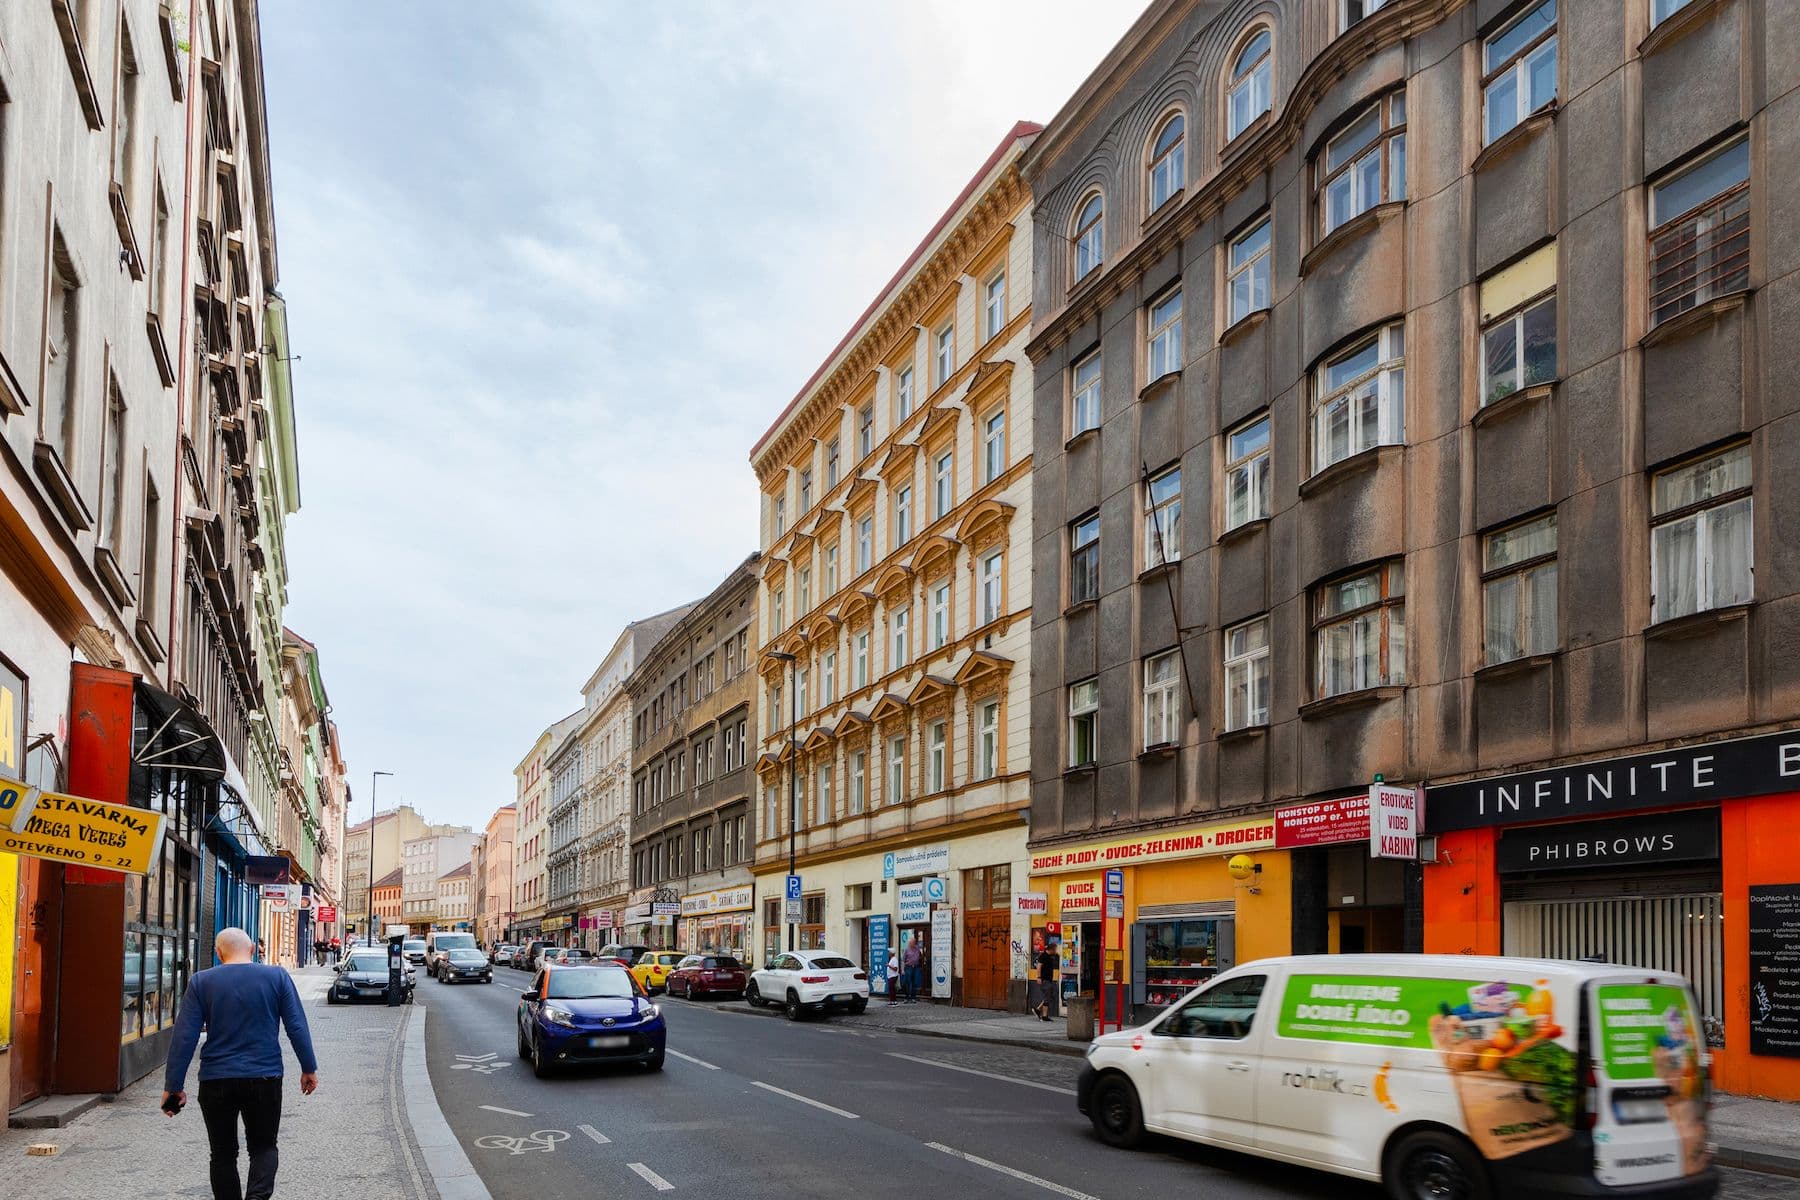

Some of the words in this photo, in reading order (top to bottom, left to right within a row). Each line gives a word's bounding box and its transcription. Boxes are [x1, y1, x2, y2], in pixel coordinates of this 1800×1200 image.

[1479, 755, 1715, 815] INFINITE
[1380, 792, 1414, 810] EROTICKÉ
[1277, 805, 1320, 819] NONSTOP
[1283, 814, 1327, 828] NONSTOP
[24, 815, 71, 839] MEGA
[1388, 815, 1409, 831] VIDEO
[5, 838, 86, 860] OTEVŘENO
[94, 853, 102, 863] 9
[117, 857, 132, 867] 22
[1033, 854, 1063, 869] SUCHÉ
[1066, 849, 1099, 865] PLODY
[1106, 834, 1203, 860] OVOCE-ZELENINA
[1214, 825, 1273, 847] DROGER
[1381, 836, 1415, 857] KABINY
[1529, 834, 1675, 861] PHIBROWS
[1066, 883, 1095, 895] OVOCE
[1018, 896, 1046, 911] Potraviny
[1061, 896, 1100, 909] ZELENINA
[1296, 1003, 1356, 1022] DOBRÉ
[1356, 1004, 1411, 1026] JÍDLO
